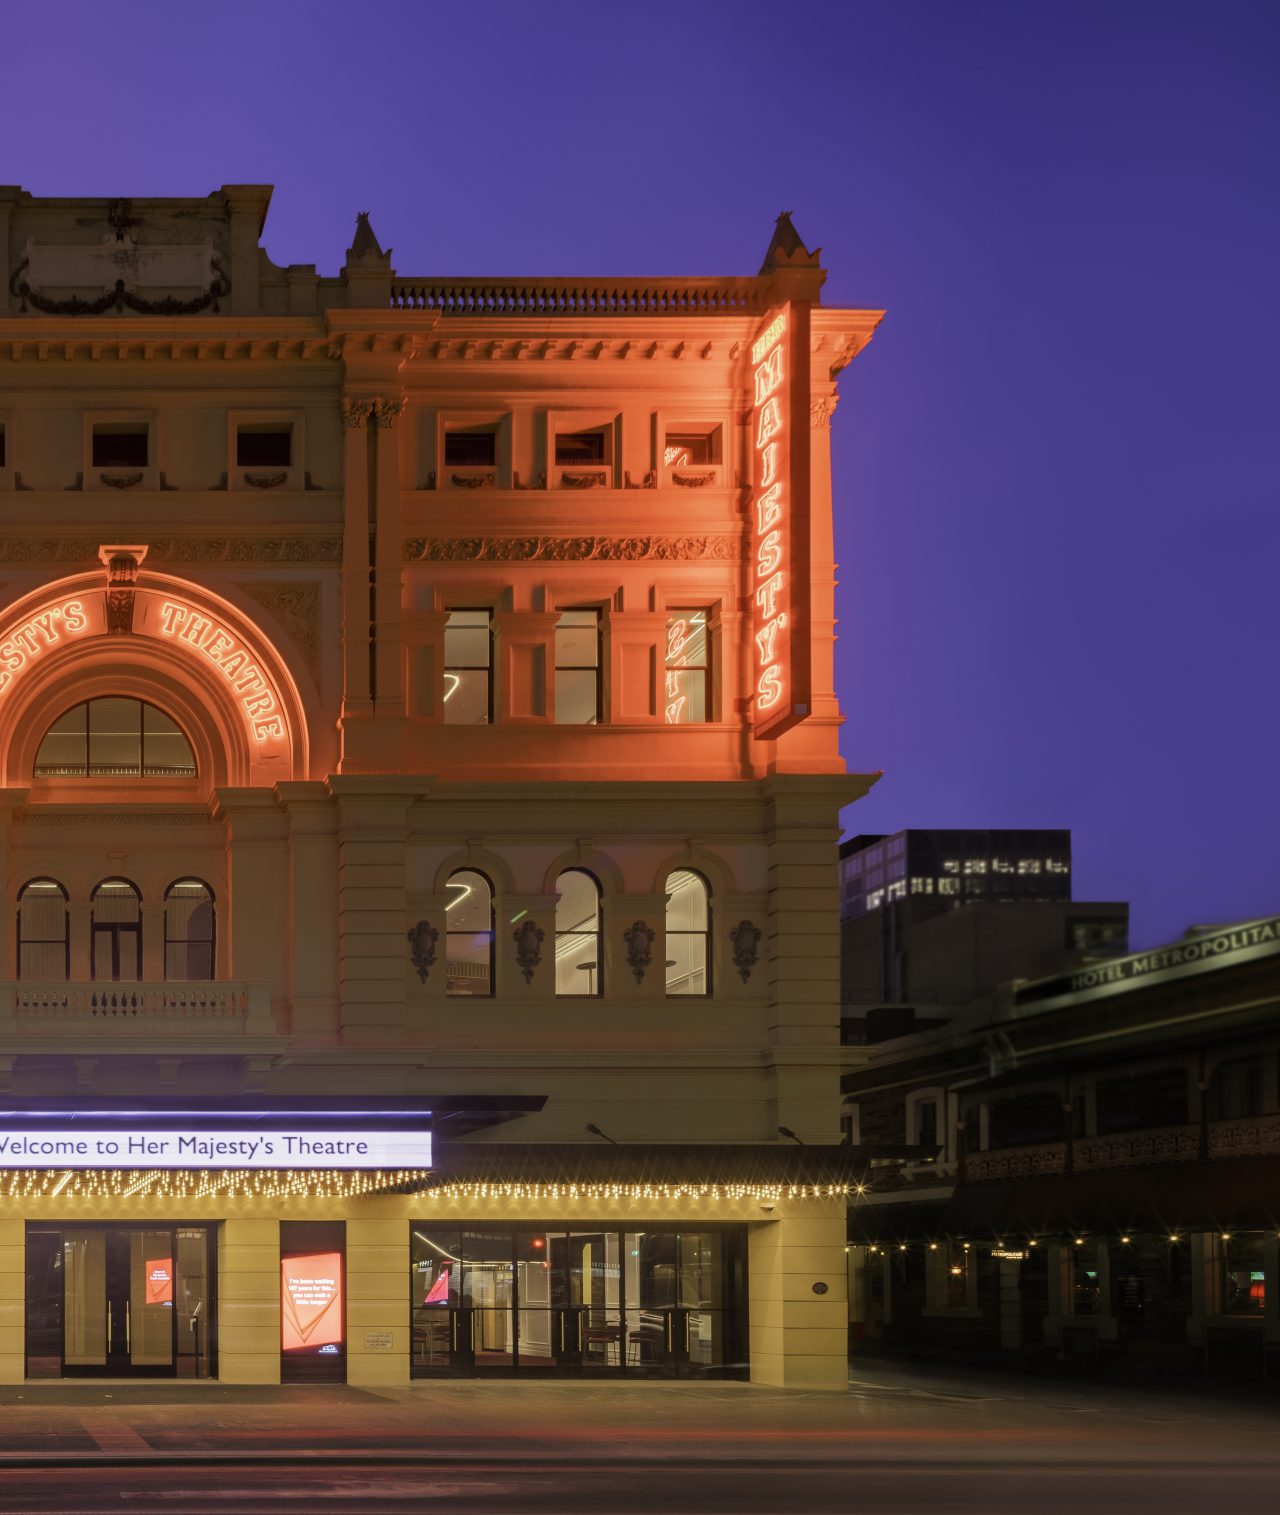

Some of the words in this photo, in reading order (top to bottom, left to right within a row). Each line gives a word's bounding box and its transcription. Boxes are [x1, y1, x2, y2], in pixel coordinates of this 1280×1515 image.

[754, 343, 789, 709] MAJESTY'S
[162, 602, 283, 741] THEATRE
[1072, 966, 1125, 990] HOTEL
[1132, 918, 1280, 975] METROPOLITA
[95, 1137, 118, 1155] to
[128, 1136, 169, 1155] Her
[178, 1136, 273, 1160] Majesty's
[281, 1136, 368, 1155] Theatre
